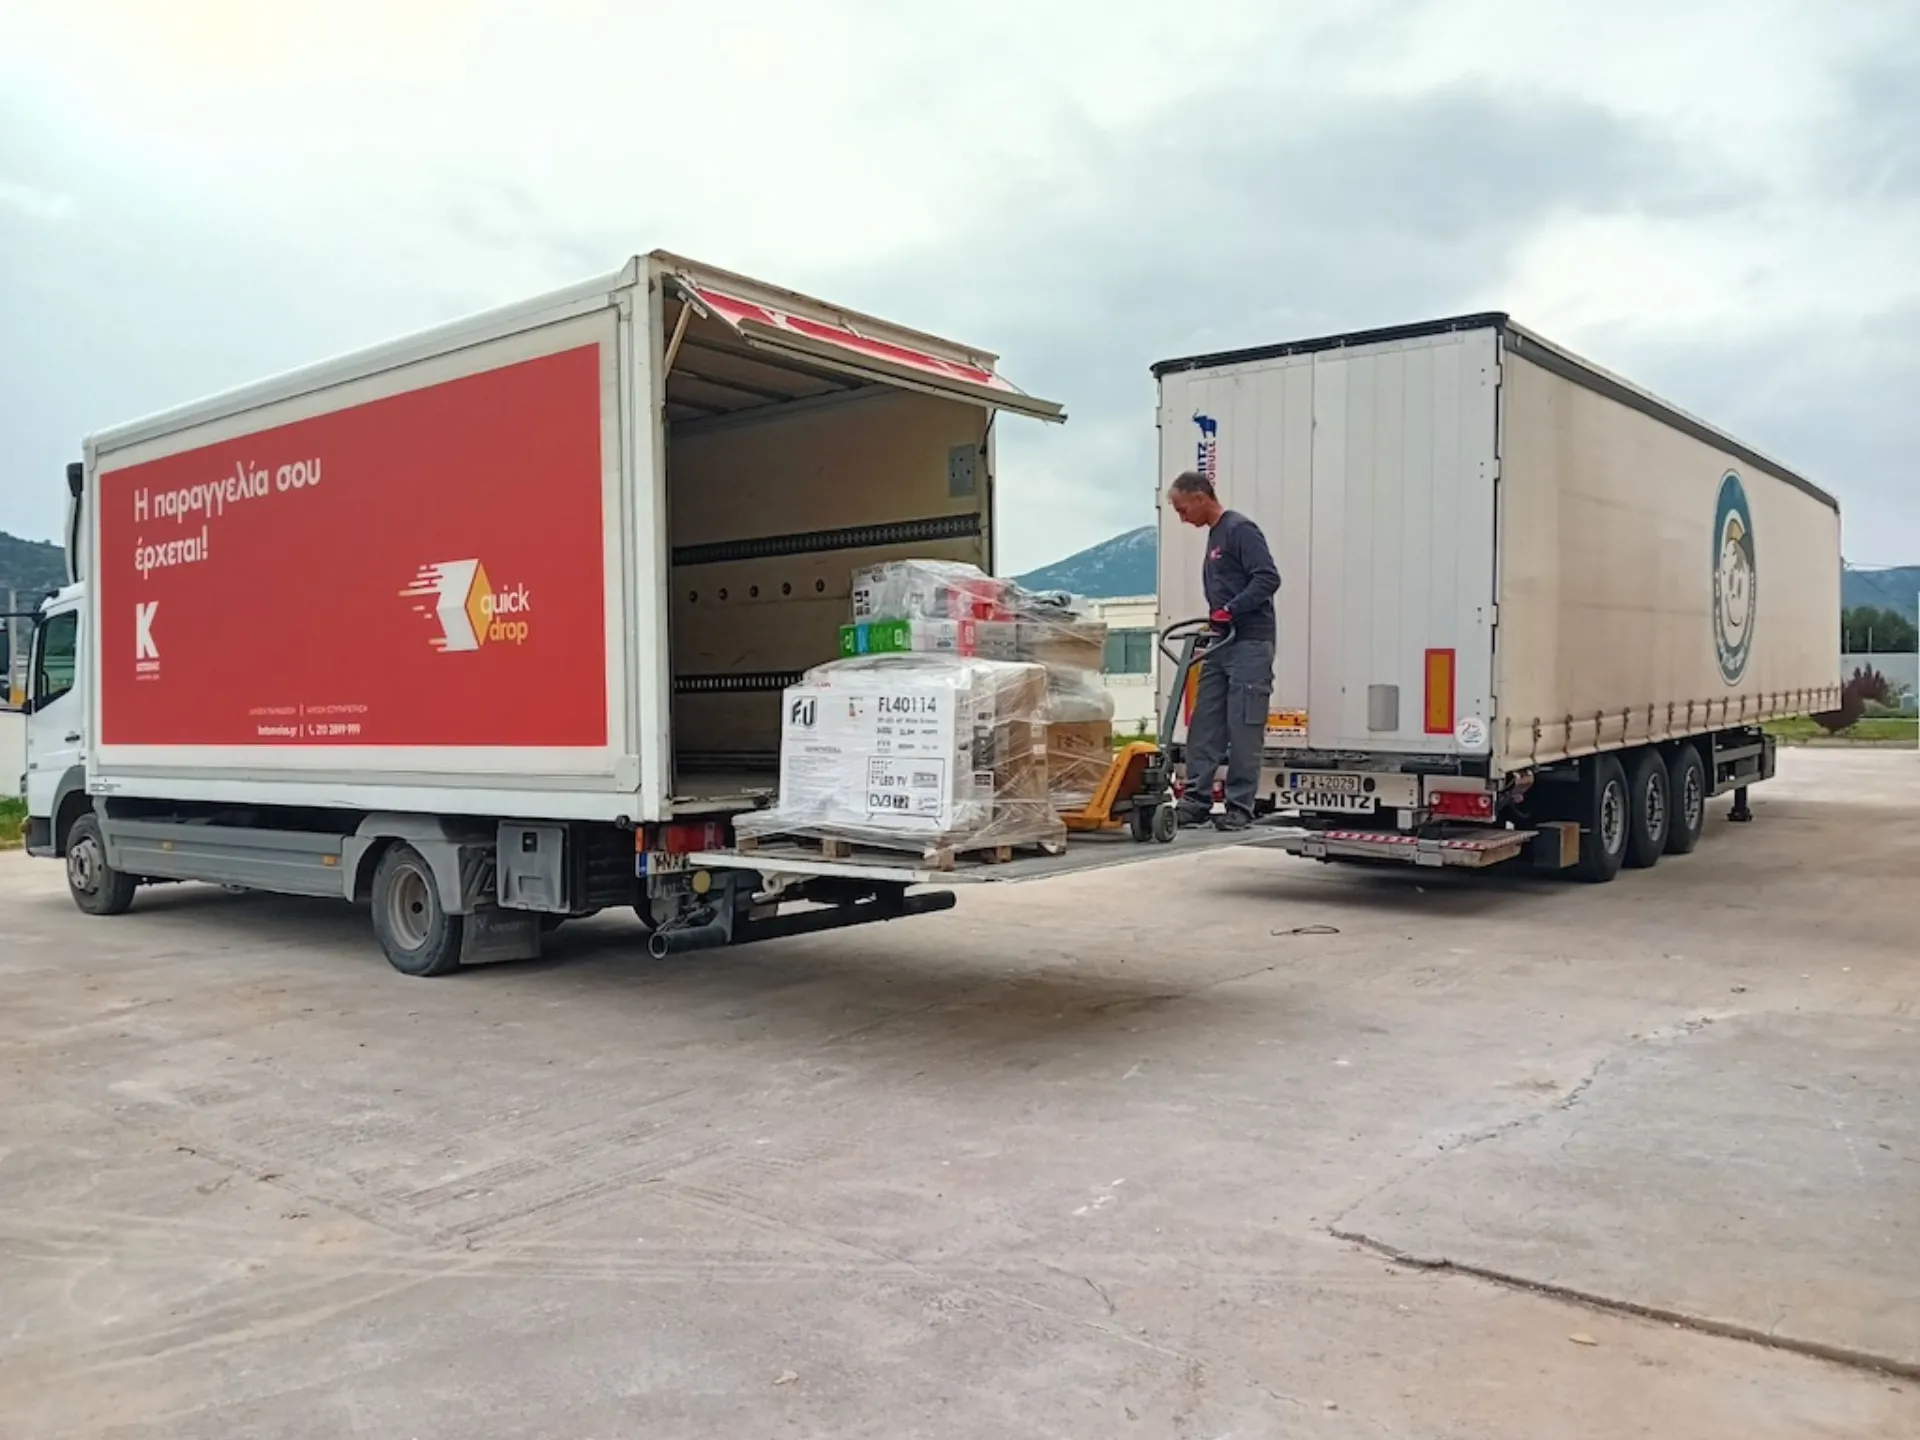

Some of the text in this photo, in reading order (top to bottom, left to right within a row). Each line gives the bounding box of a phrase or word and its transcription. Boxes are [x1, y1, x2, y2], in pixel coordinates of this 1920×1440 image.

[155, 460, 269, 524] παραγγελία
[276, 457, 321, 492] σου
[135, 524, 208, 580] έρχεται!
[480, 582, 531, 621] quick
[489, 616, 528, 645] drop
[879, 697, 936, 713] FL40114
[1281, 791, 1371, 809] SCHMITZ
